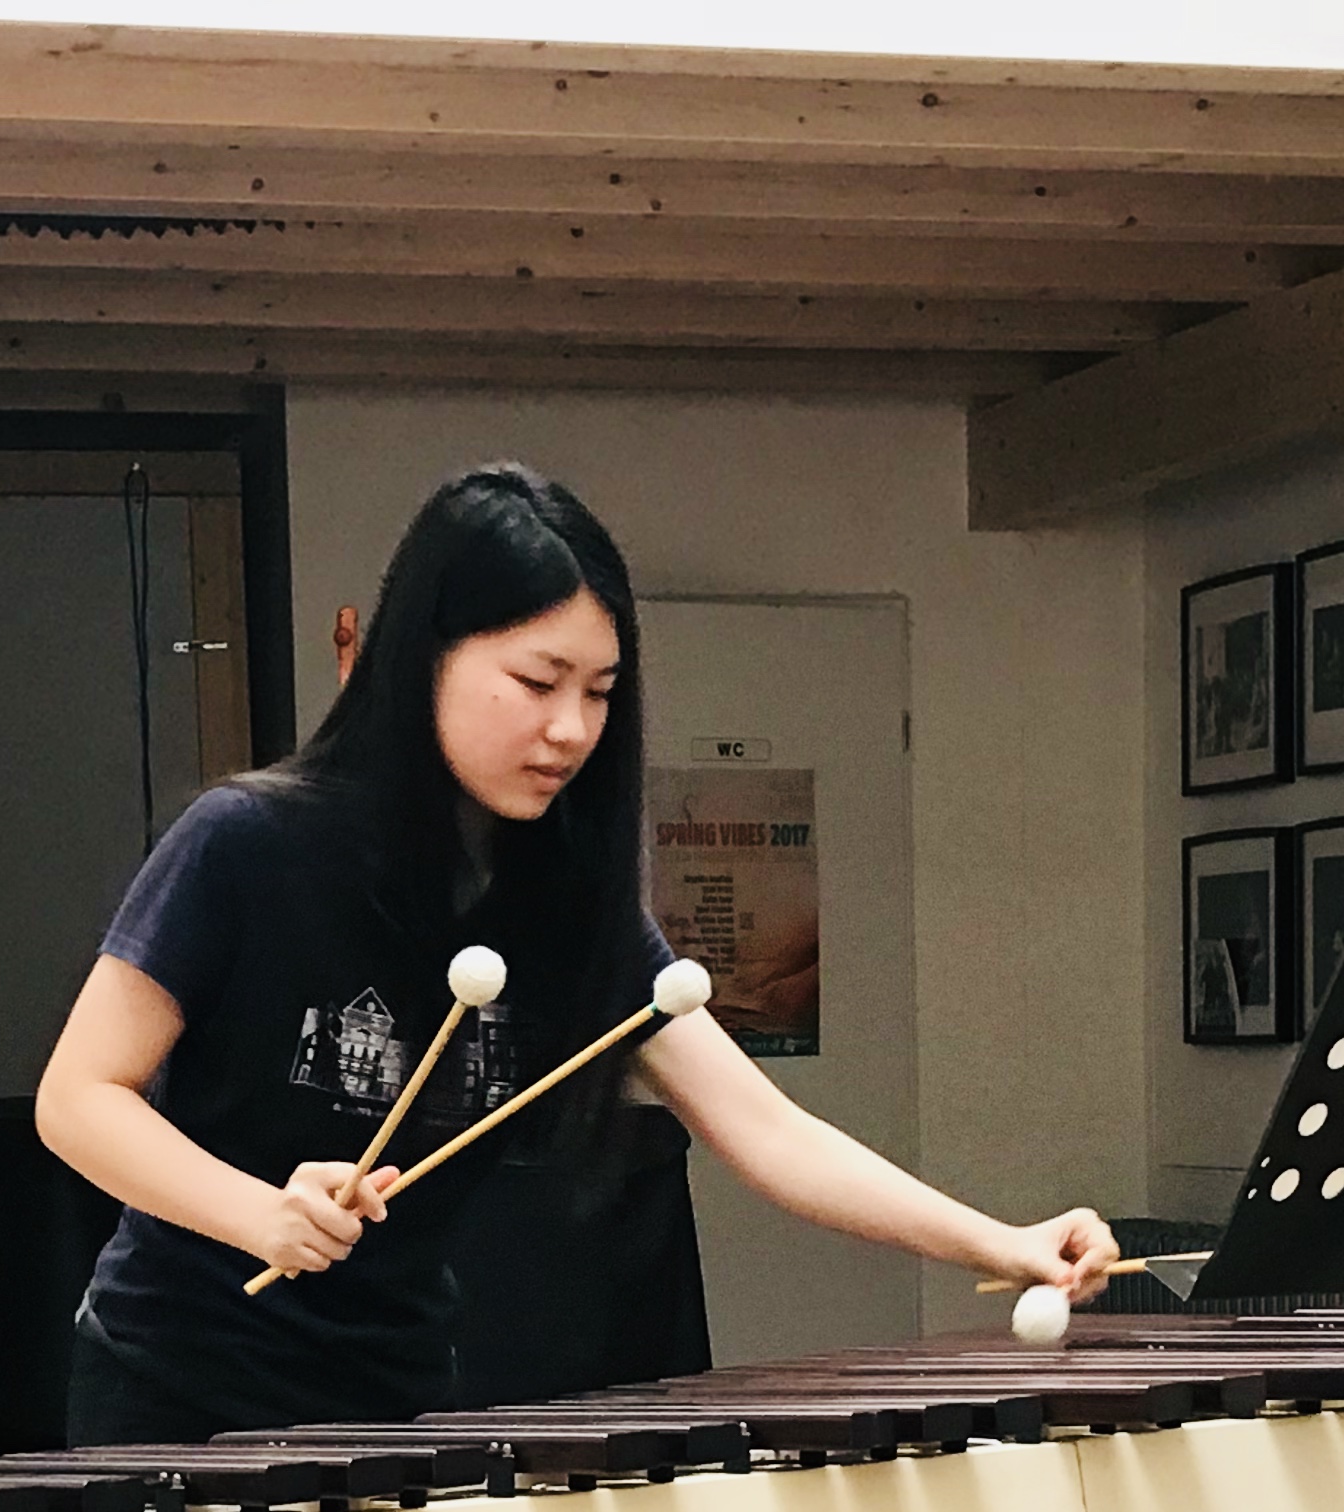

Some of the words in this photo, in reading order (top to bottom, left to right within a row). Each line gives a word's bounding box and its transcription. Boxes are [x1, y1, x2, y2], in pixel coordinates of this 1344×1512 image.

[717, 742, 745, 757] WC
[656, 822, 716, 847] SPRING
[718, 822, 766, 847] VIBES
[770, 823, 810, 847] 2017
